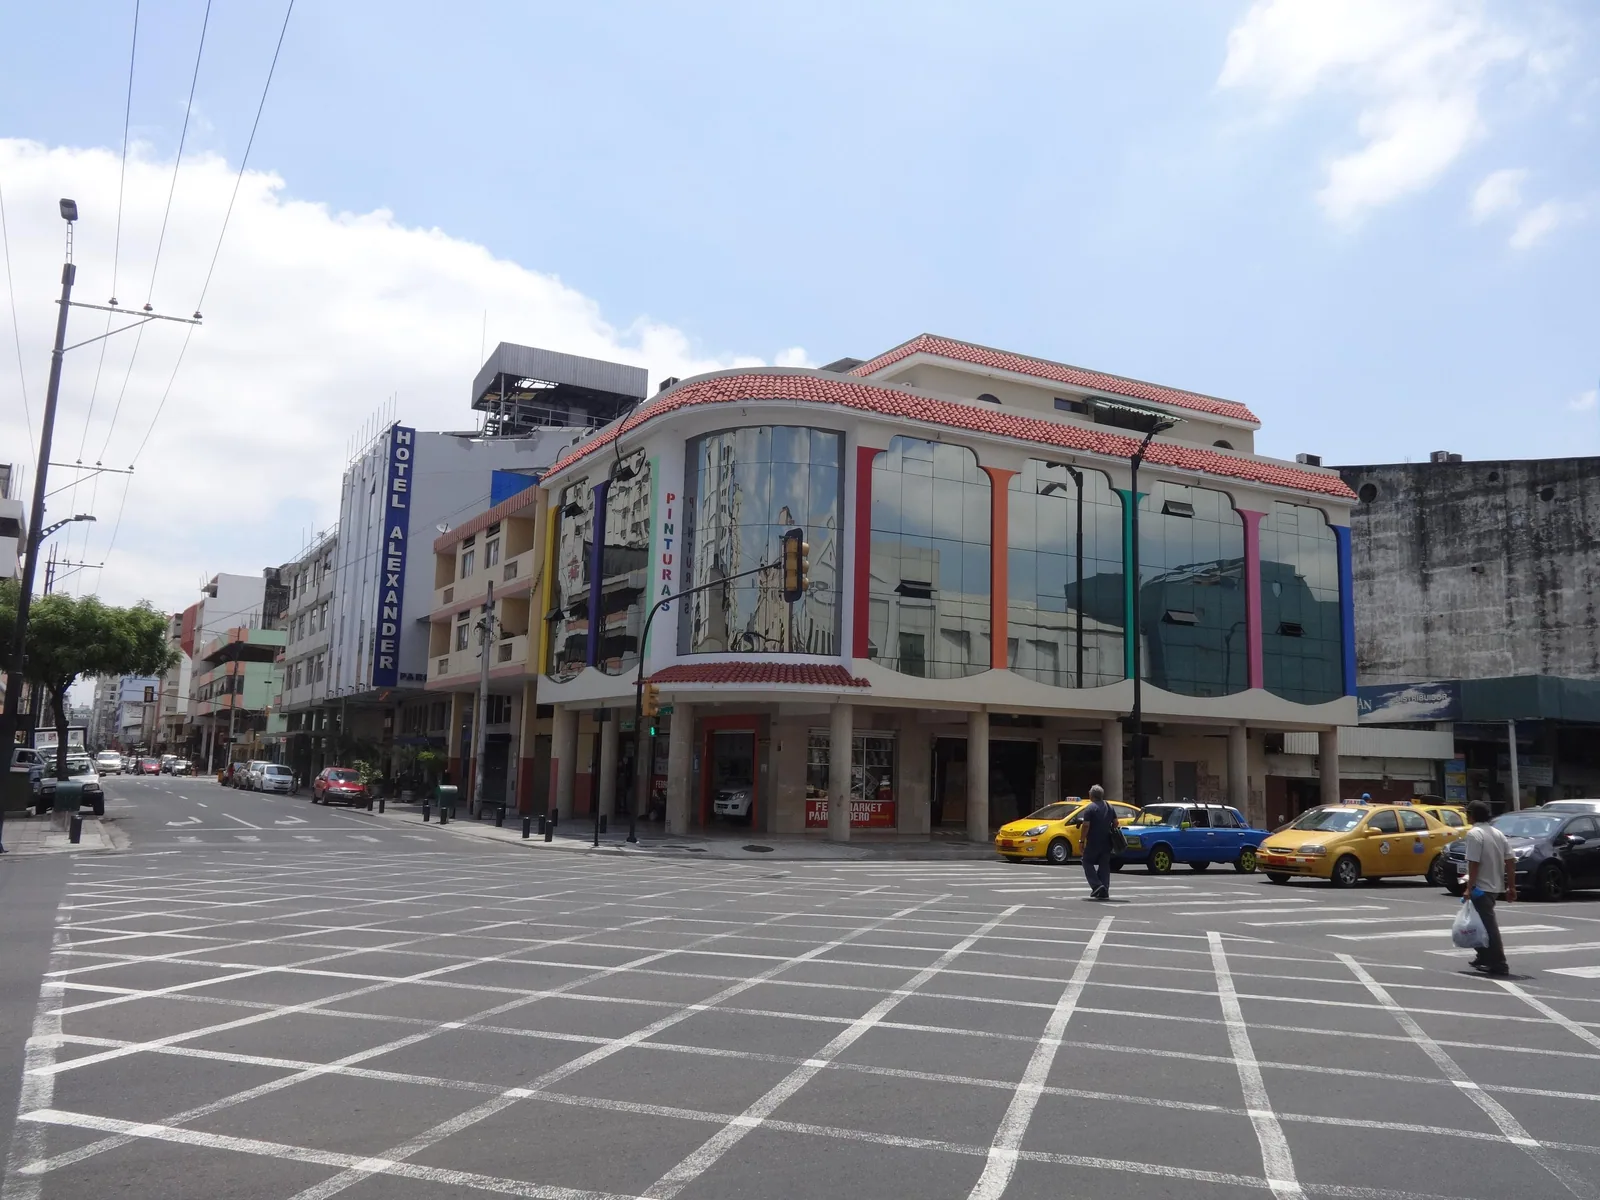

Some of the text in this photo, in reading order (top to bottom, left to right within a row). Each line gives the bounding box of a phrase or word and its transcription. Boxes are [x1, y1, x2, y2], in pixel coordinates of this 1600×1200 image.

[380, 431, 411, 670] HOTEL ALEXANDER
[661, 492, 676, 612] PINTURAS
